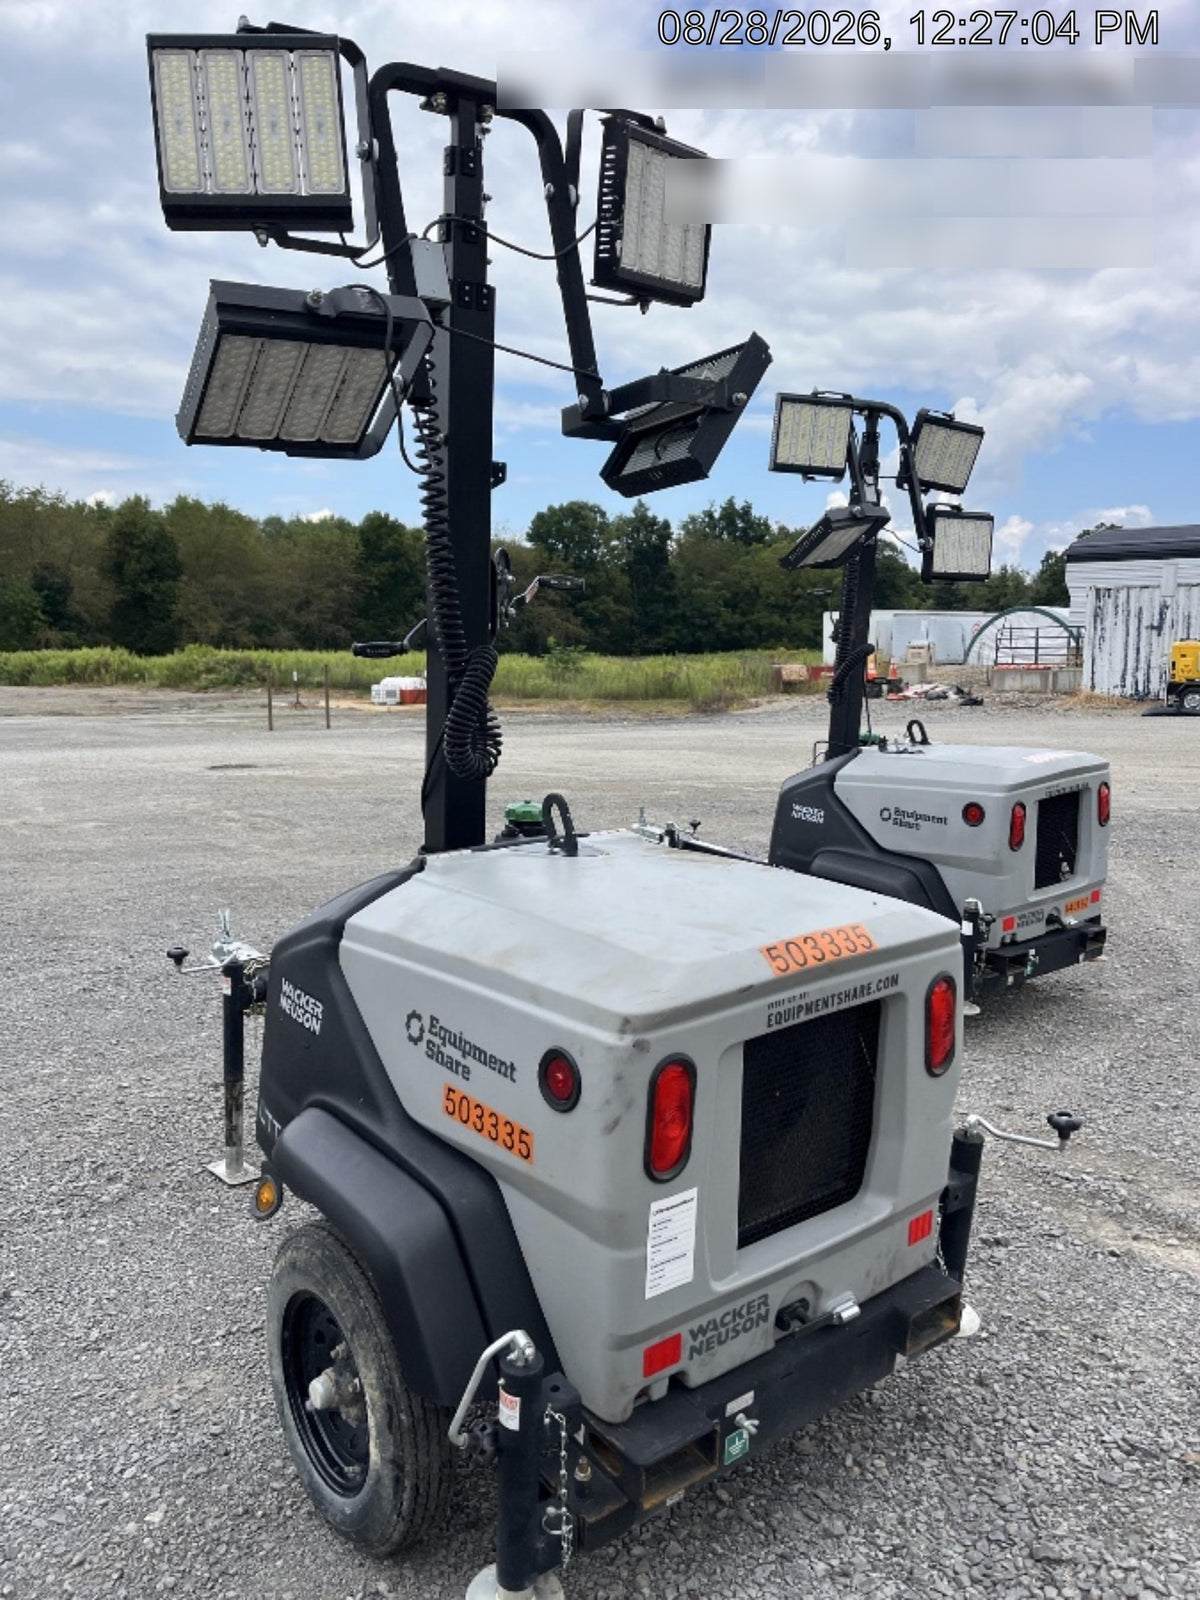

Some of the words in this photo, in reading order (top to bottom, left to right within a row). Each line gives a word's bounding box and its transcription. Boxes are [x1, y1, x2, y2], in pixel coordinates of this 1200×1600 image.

[894, 806, 948, 826] Equipment
[765, 925, 873, 973] 503335
[280, 993, 323, 1035] NEUSON
[282, 977, 323, 1019] WACKER
[766, 973, 899, 1029] EQUIPMENTSHARE.COM
[425, 1039, 472, 1081] Share
[428, 1014, 518, 1083] Equipment
[445, 1086, 532, 1160] 503335
[688, 1293, 770, 1342] WACKER
[688, 1308, 770, 1361] NEUSON
